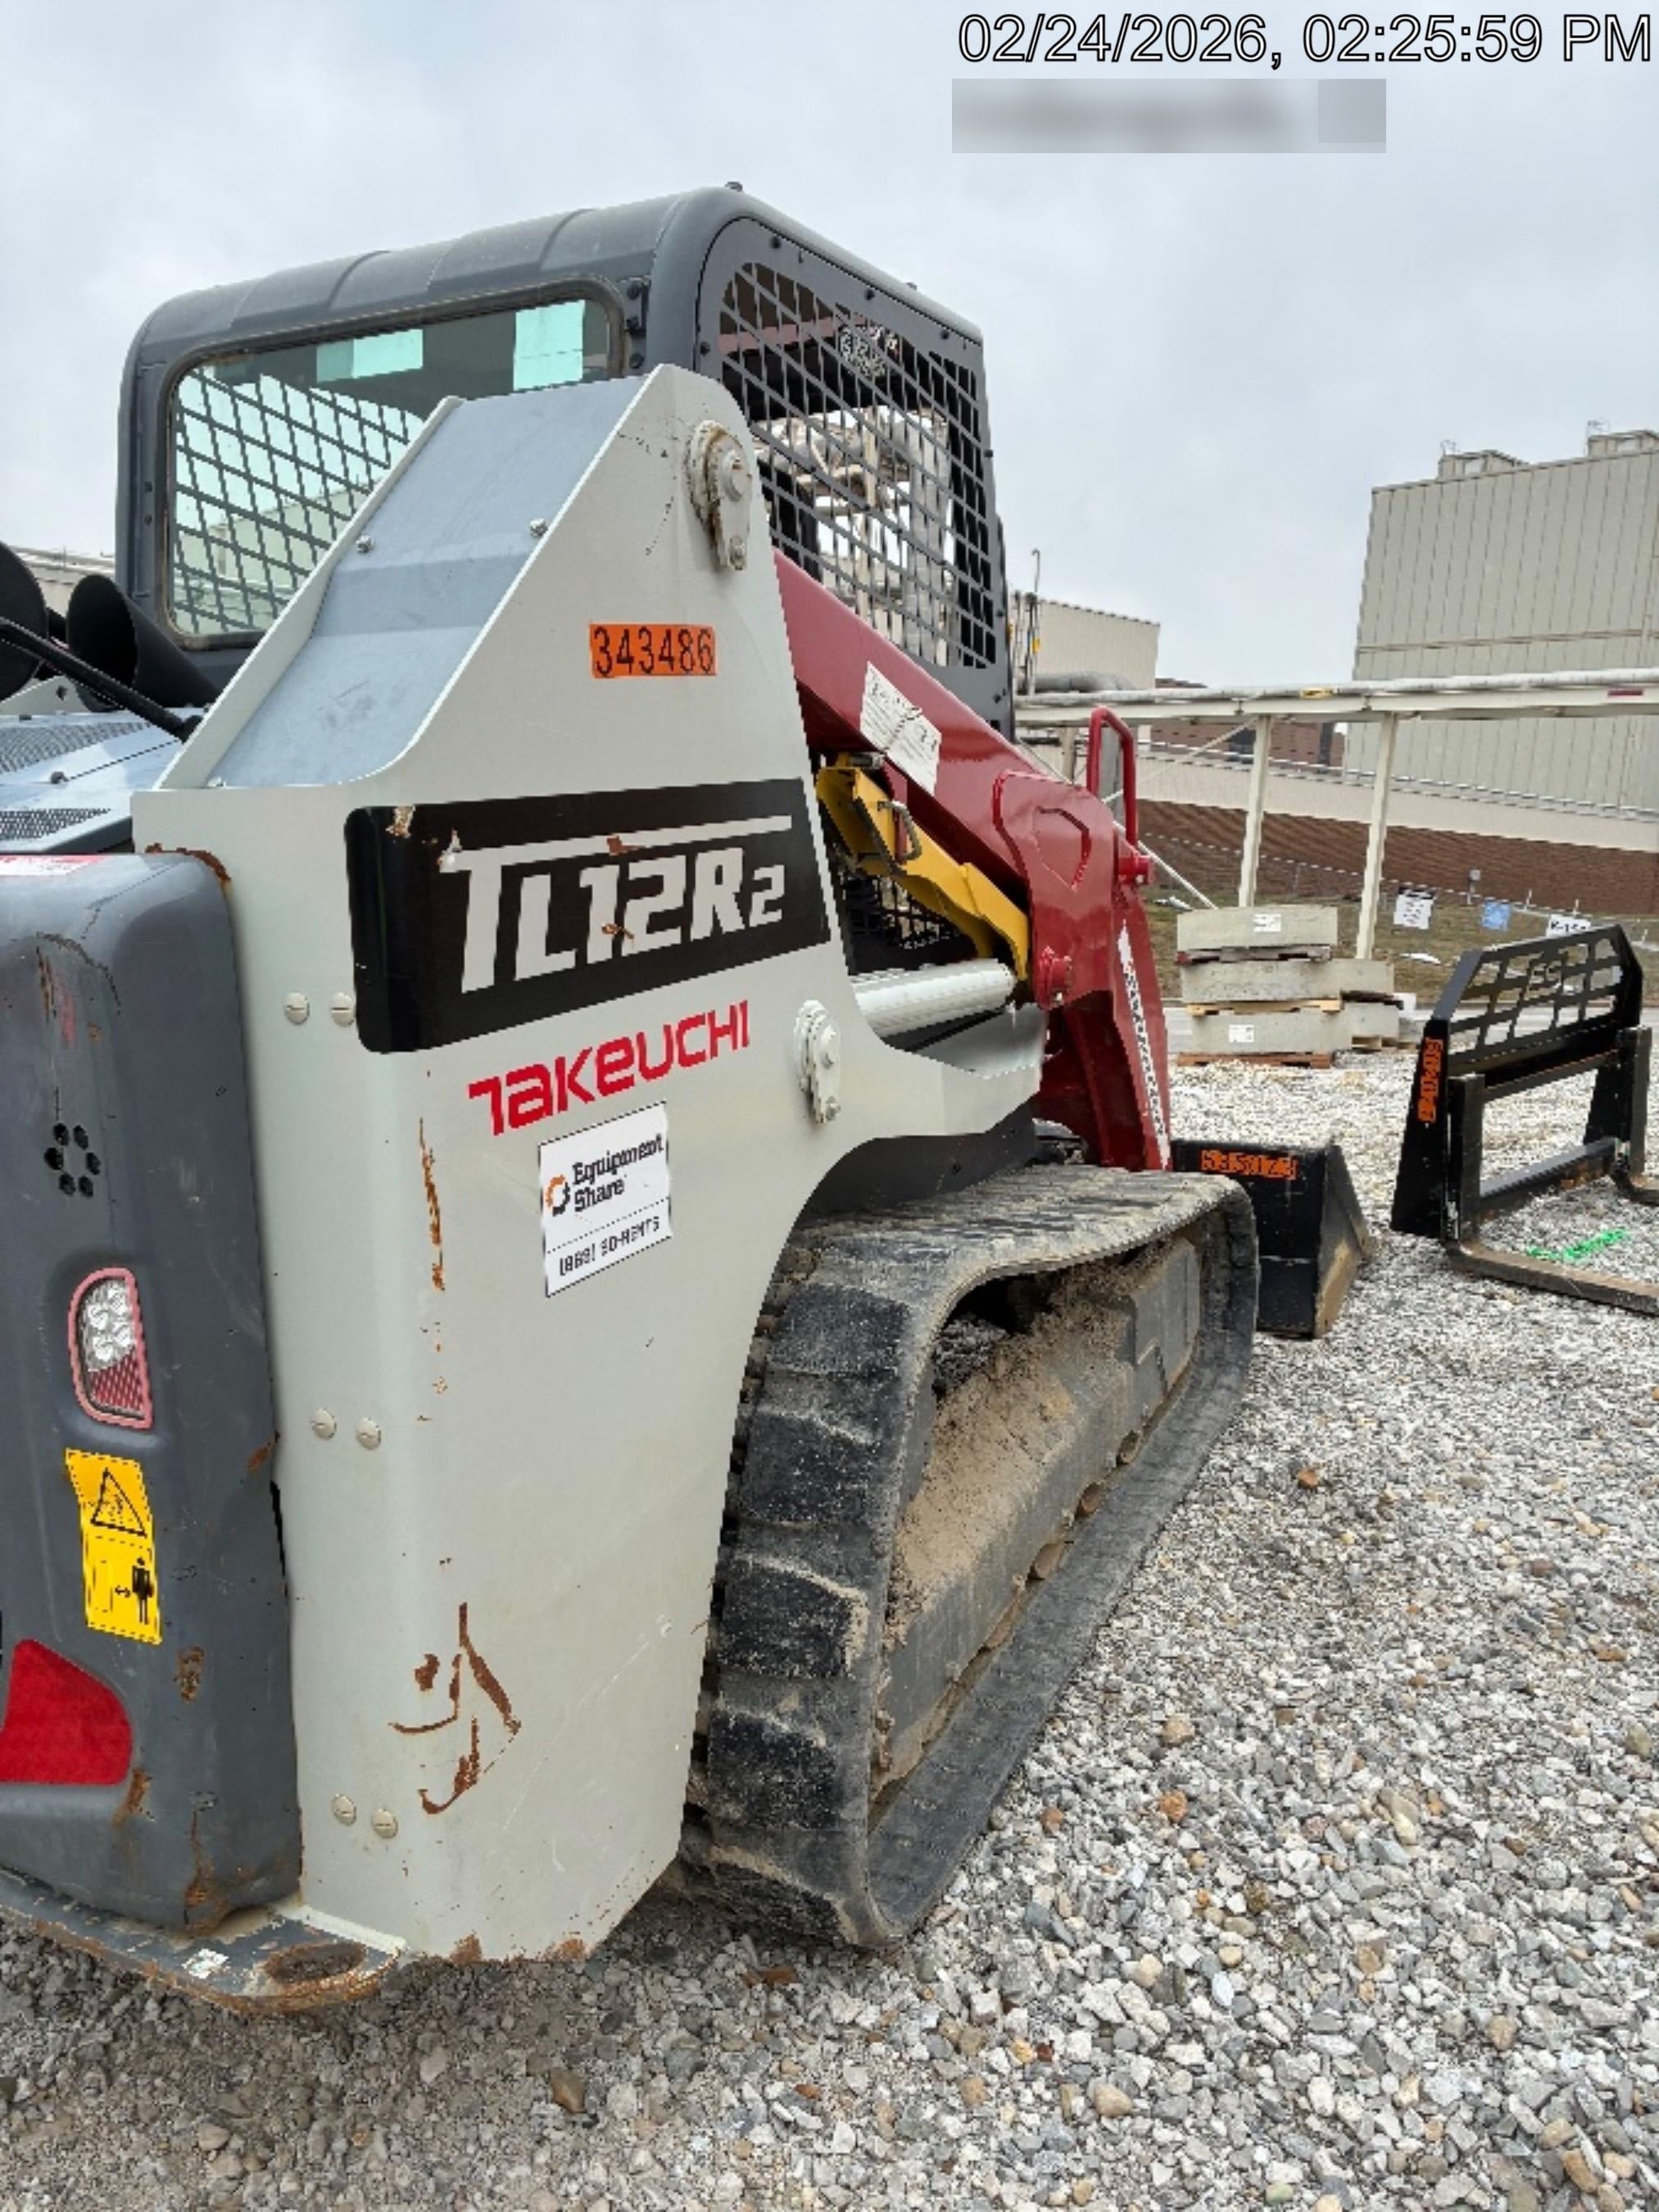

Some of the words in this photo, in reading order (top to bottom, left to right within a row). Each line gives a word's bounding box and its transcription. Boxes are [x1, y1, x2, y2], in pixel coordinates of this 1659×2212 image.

[592, 626, 714, 675] 343486
[438, 815, 792, 994] TL12R2
[572, 1133, 664, 1186] Equipment
[573, 1180, 625, 1213] Share
